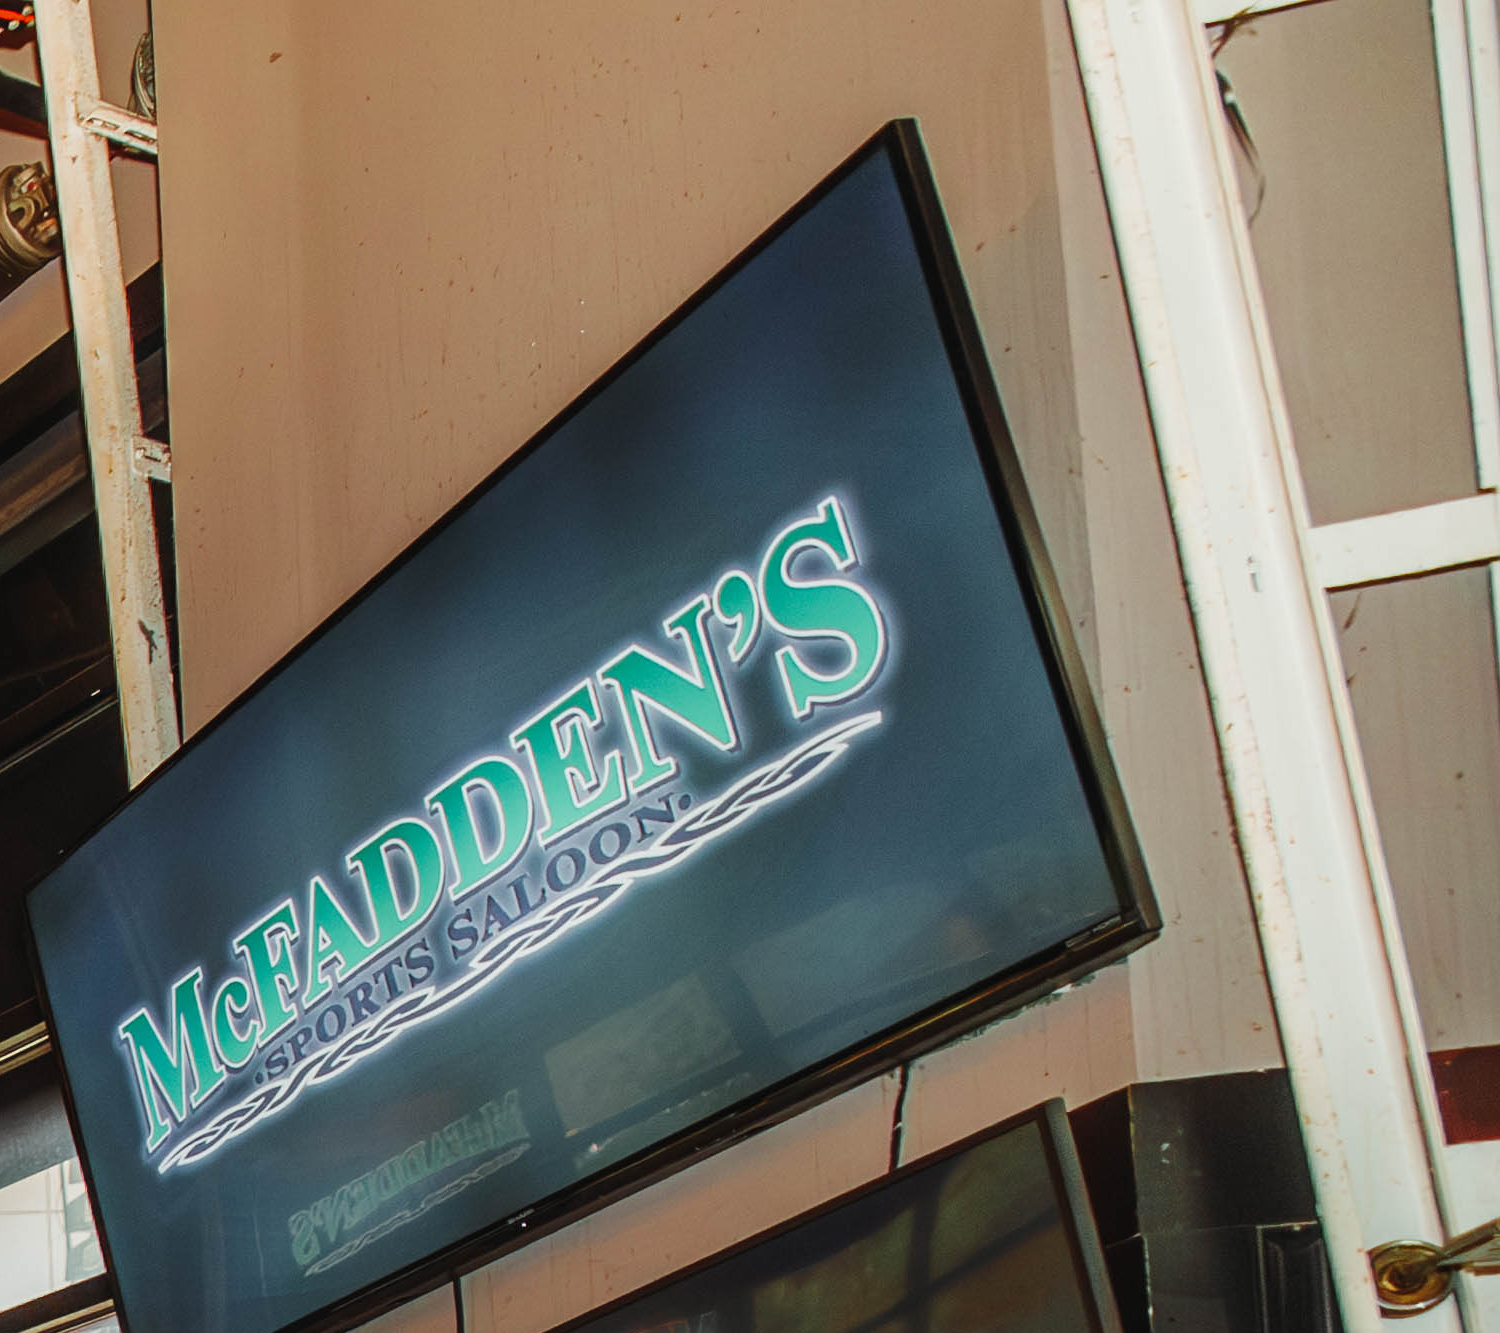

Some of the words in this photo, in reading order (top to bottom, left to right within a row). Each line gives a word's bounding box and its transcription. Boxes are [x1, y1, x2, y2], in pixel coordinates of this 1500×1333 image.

[117, 495, 892, 1153] McFADDEN'S
[263, 945, 436, 1083] SPORTS
[446, 797, 677, 961] SALOON
